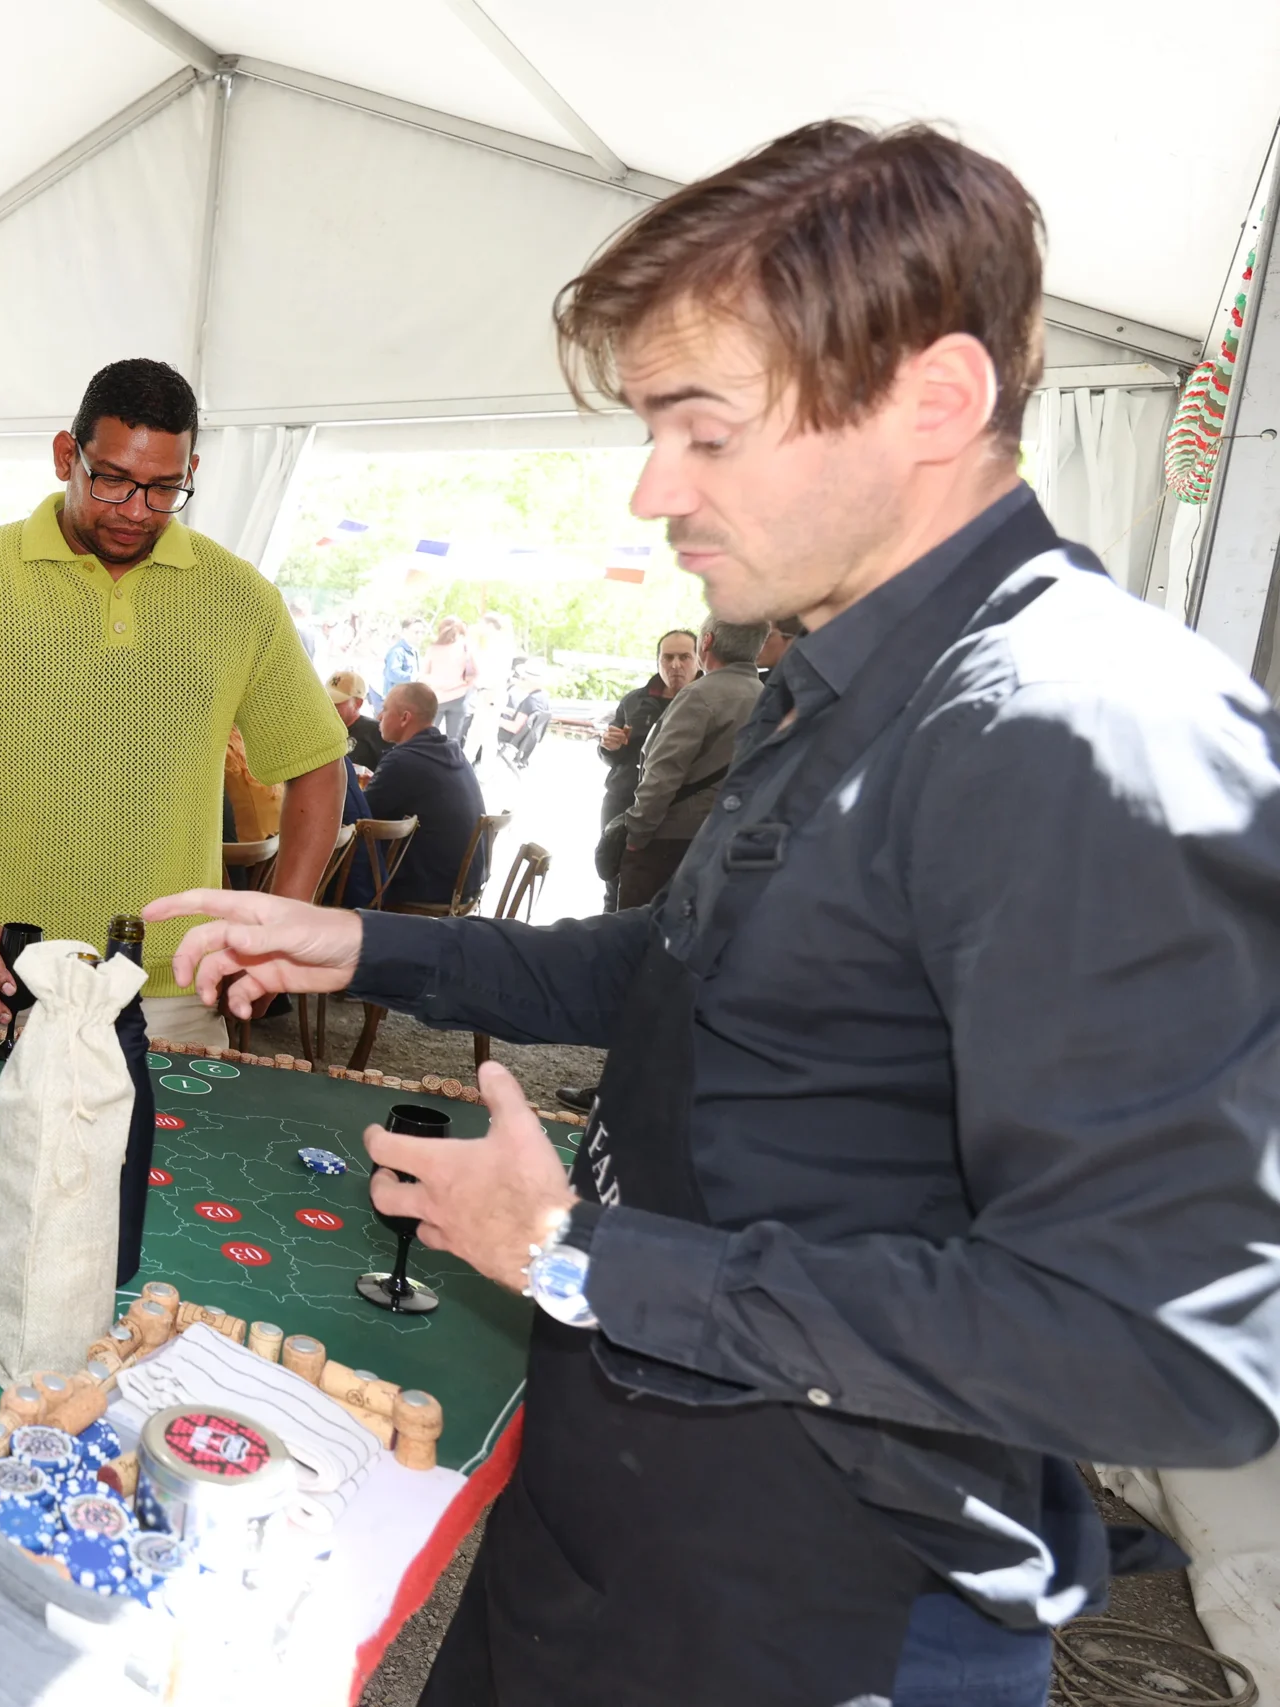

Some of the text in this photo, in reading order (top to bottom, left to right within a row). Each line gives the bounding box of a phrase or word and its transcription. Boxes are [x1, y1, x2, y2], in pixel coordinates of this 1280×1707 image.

[208, 1064, 221, 1074] 2
[181, 1079, 192, 1089] 1
[202, 1206, 234, 1218] 02
[304, 1213, 335, 1225] 04
[229, 1247, 263, 1261] 03
